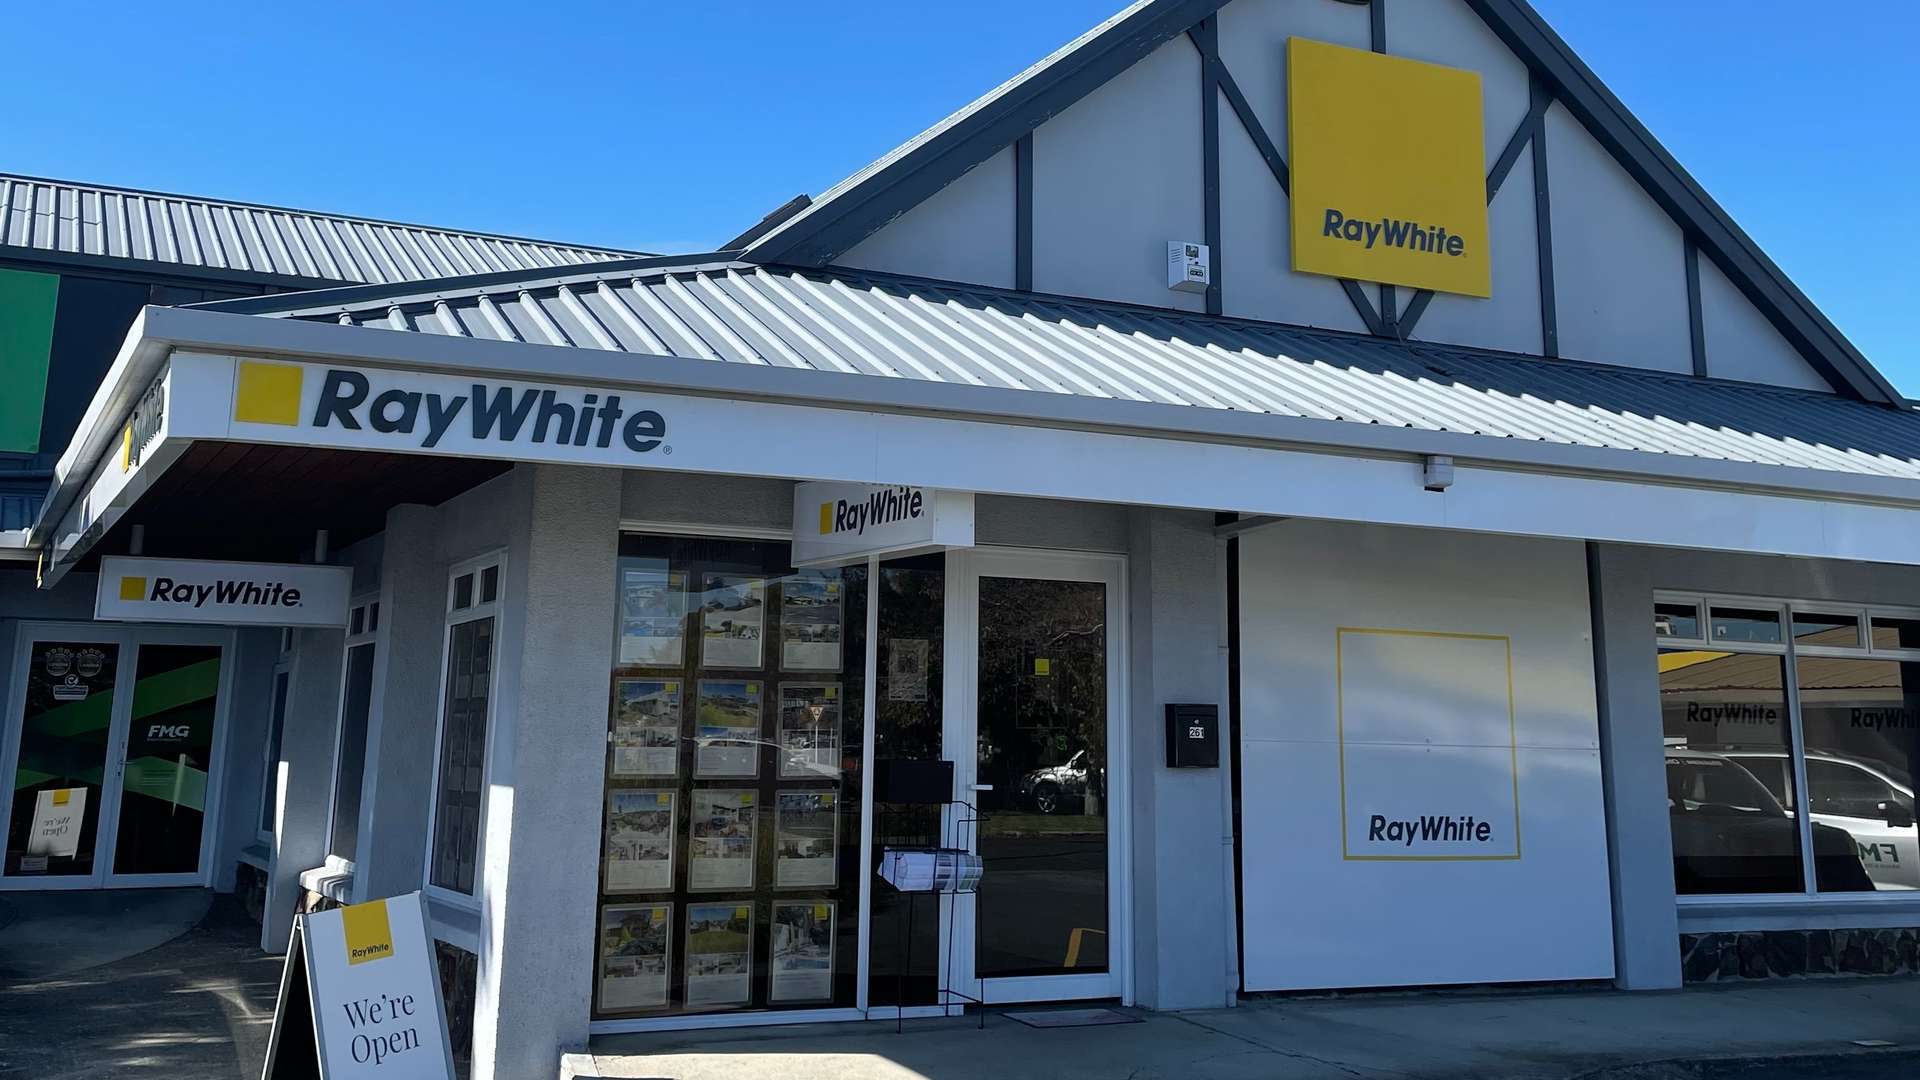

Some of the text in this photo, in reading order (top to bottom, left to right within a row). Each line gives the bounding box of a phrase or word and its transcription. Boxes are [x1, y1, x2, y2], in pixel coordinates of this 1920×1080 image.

[1323, 208, 1464, 256] RayWhite
[312, 369, 666, 452] RayWhite
[834, 487, 922, 536] RayWhite
[150, 577, 301, 608] RayWhite
[147, 725, 190, 738] FMG
[1851, 707, 1920, 732] RayWhi
[1369, 814, 1491, 847] RayWhite
[352, 943, 390, 959] RayWhite
[351, 1026, 420, 1066] Open
